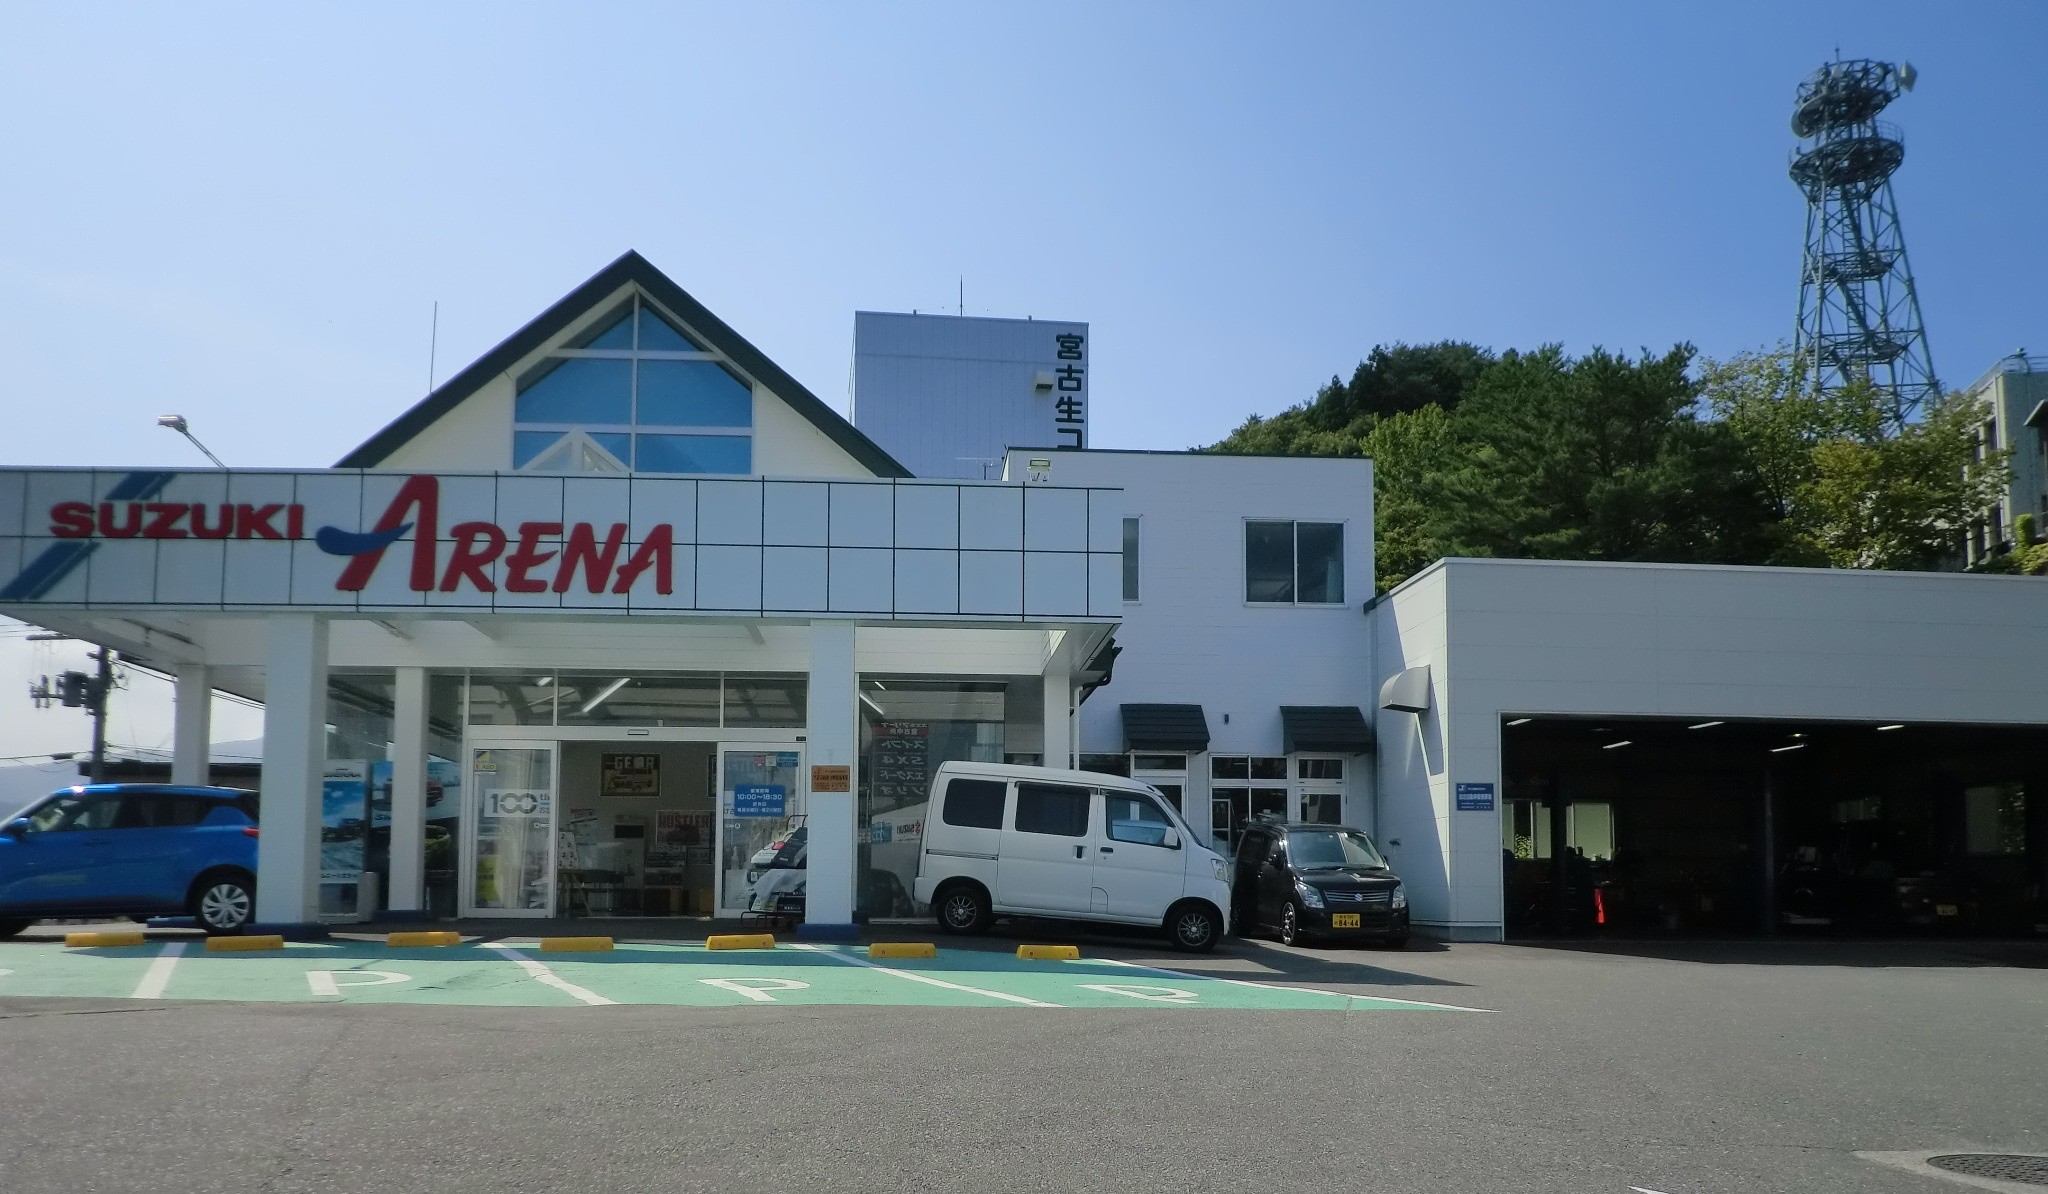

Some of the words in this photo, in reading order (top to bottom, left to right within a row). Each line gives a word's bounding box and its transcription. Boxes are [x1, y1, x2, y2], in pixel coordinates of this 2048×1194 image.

[1055, 332, 1085, 449] 宮古生コ
[49, 501, 305, 541] SUZUKI
[315, 474, 674, 596] ARENA
[490, 792, 538, 814] 100
